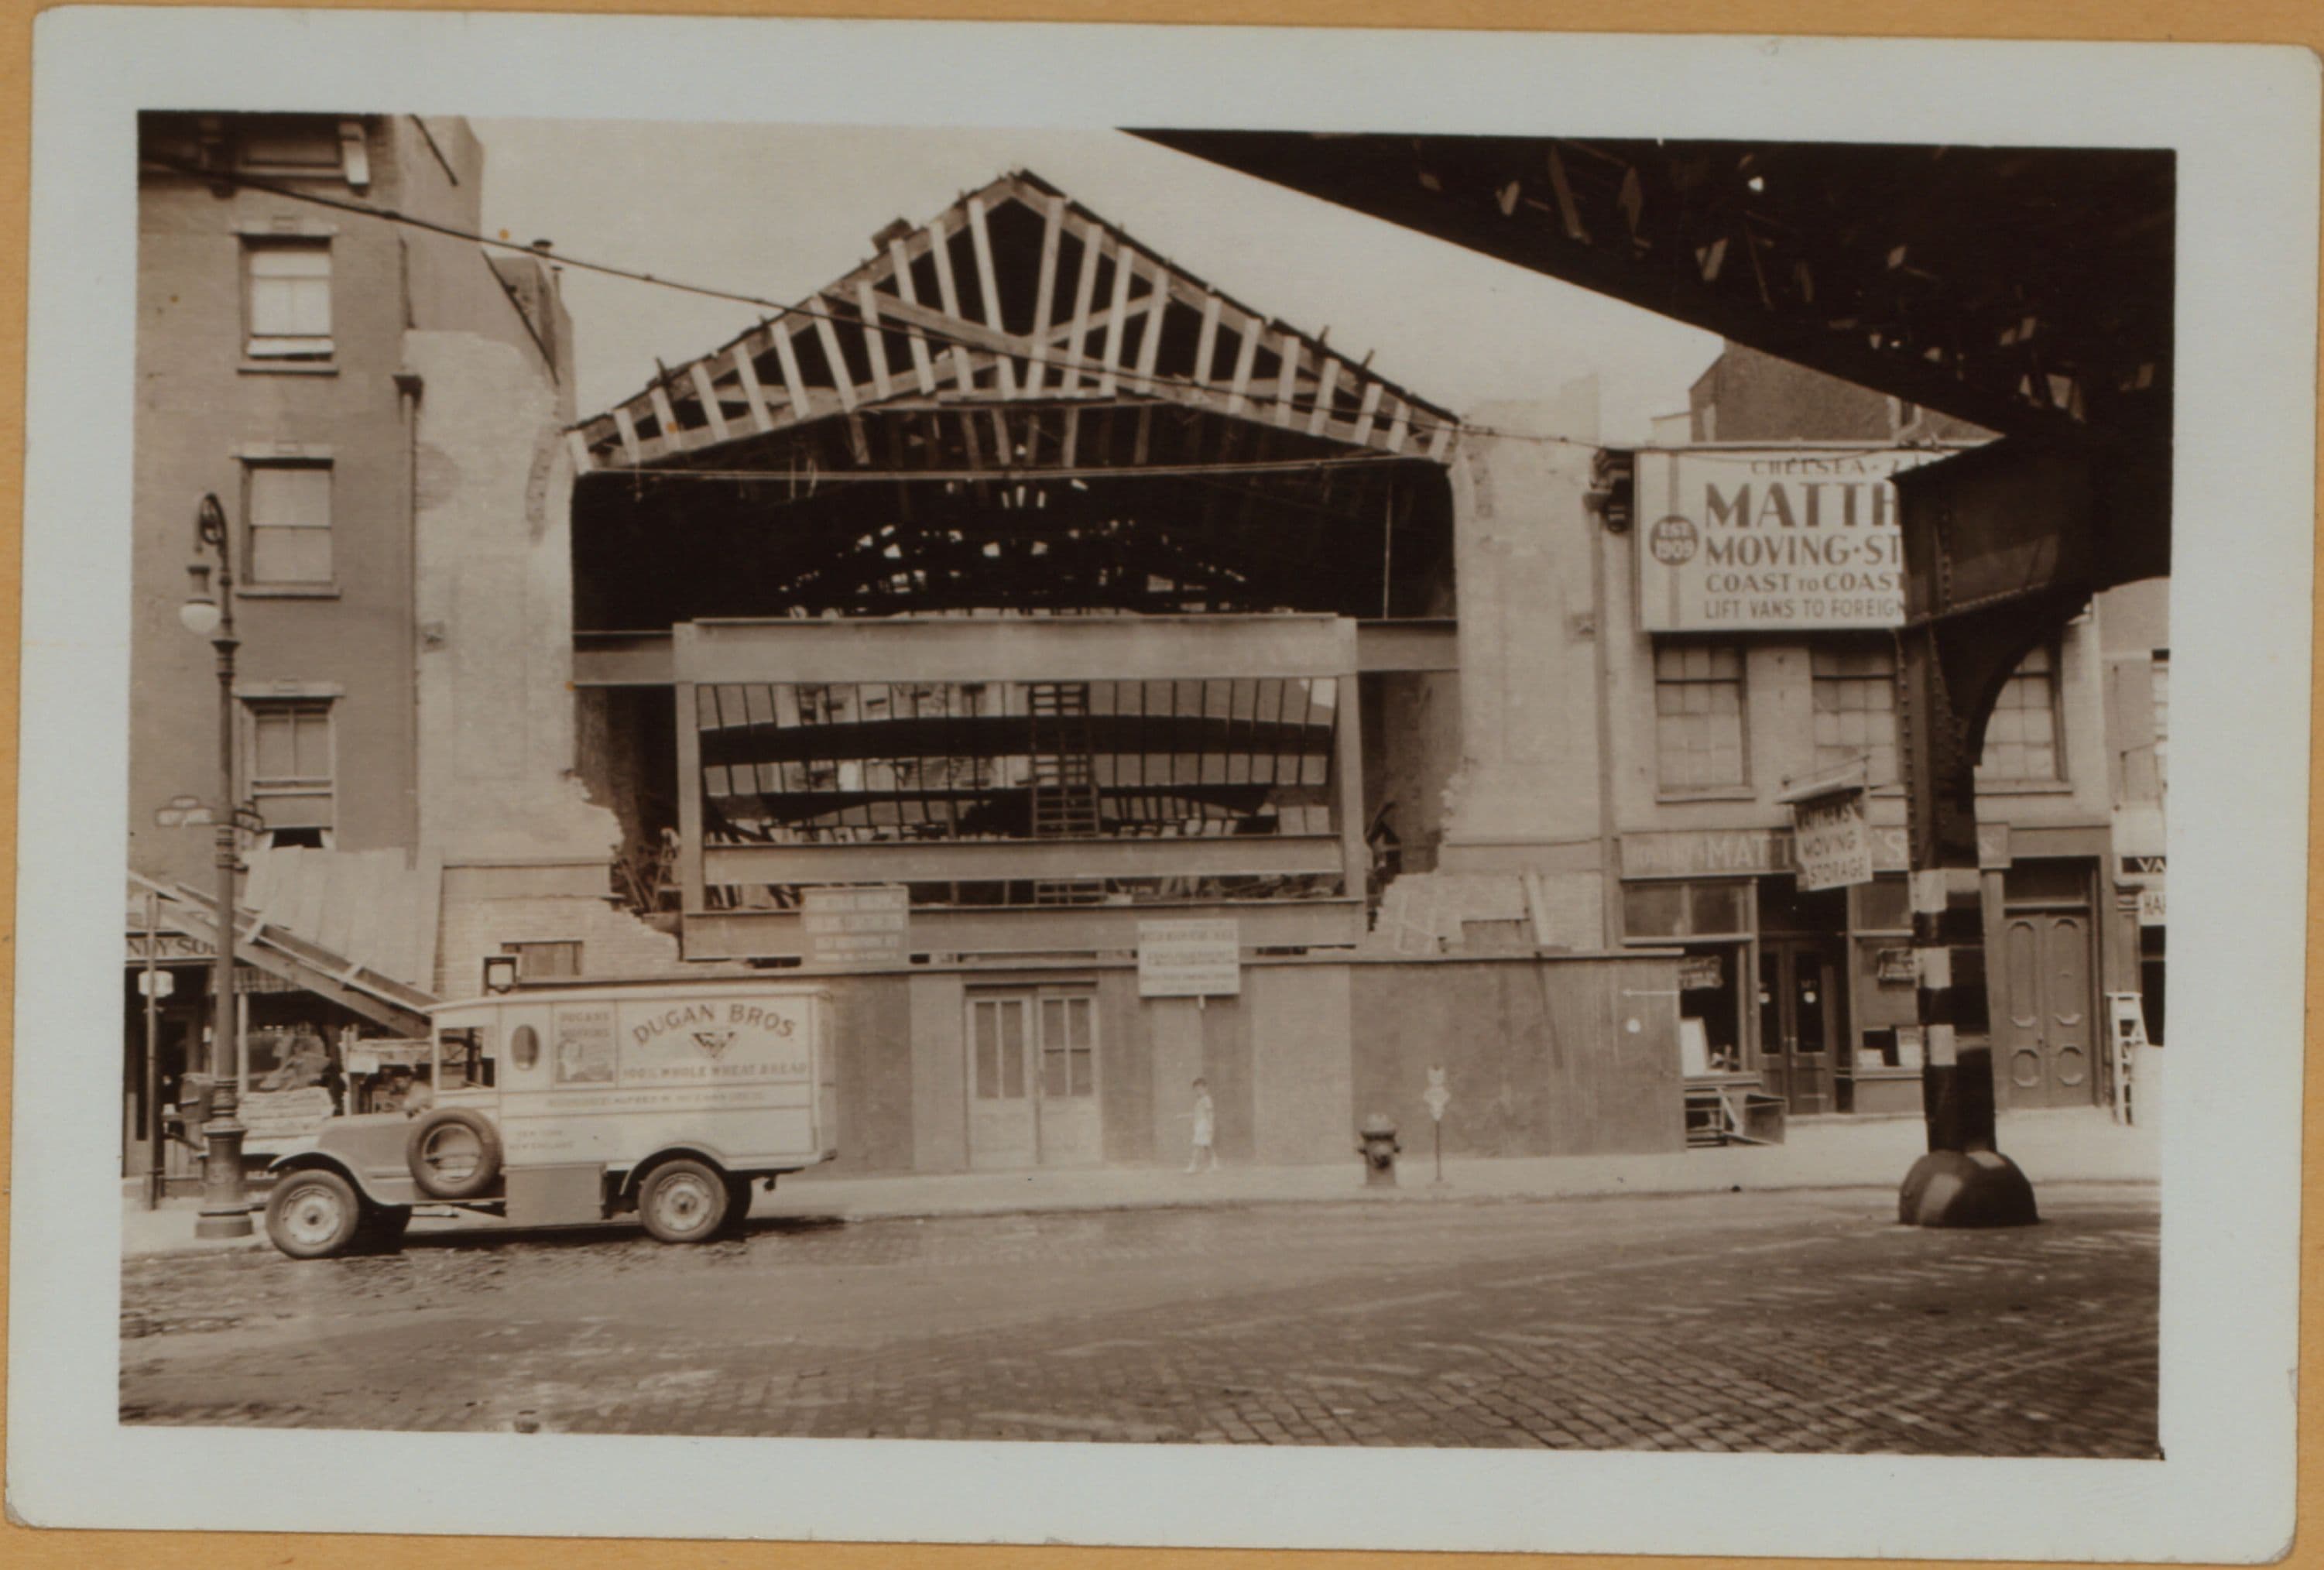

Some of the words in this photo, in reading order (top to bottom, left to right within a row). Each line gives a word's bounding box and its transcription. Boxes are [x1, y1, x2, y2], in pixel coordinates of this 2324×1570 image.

[1705, 573, 1791, 593] COAST
[1705, 600, 1740, 620] LIFT
[1749, 598, 1794, 619] VANS
[1804, 598, 1825, 619] TO
[1802, 829, 1857, 857] MOVING
[1810, 855, 1866, 886] STORAGE
[632, 1004, 715, 1046] DUGAN
